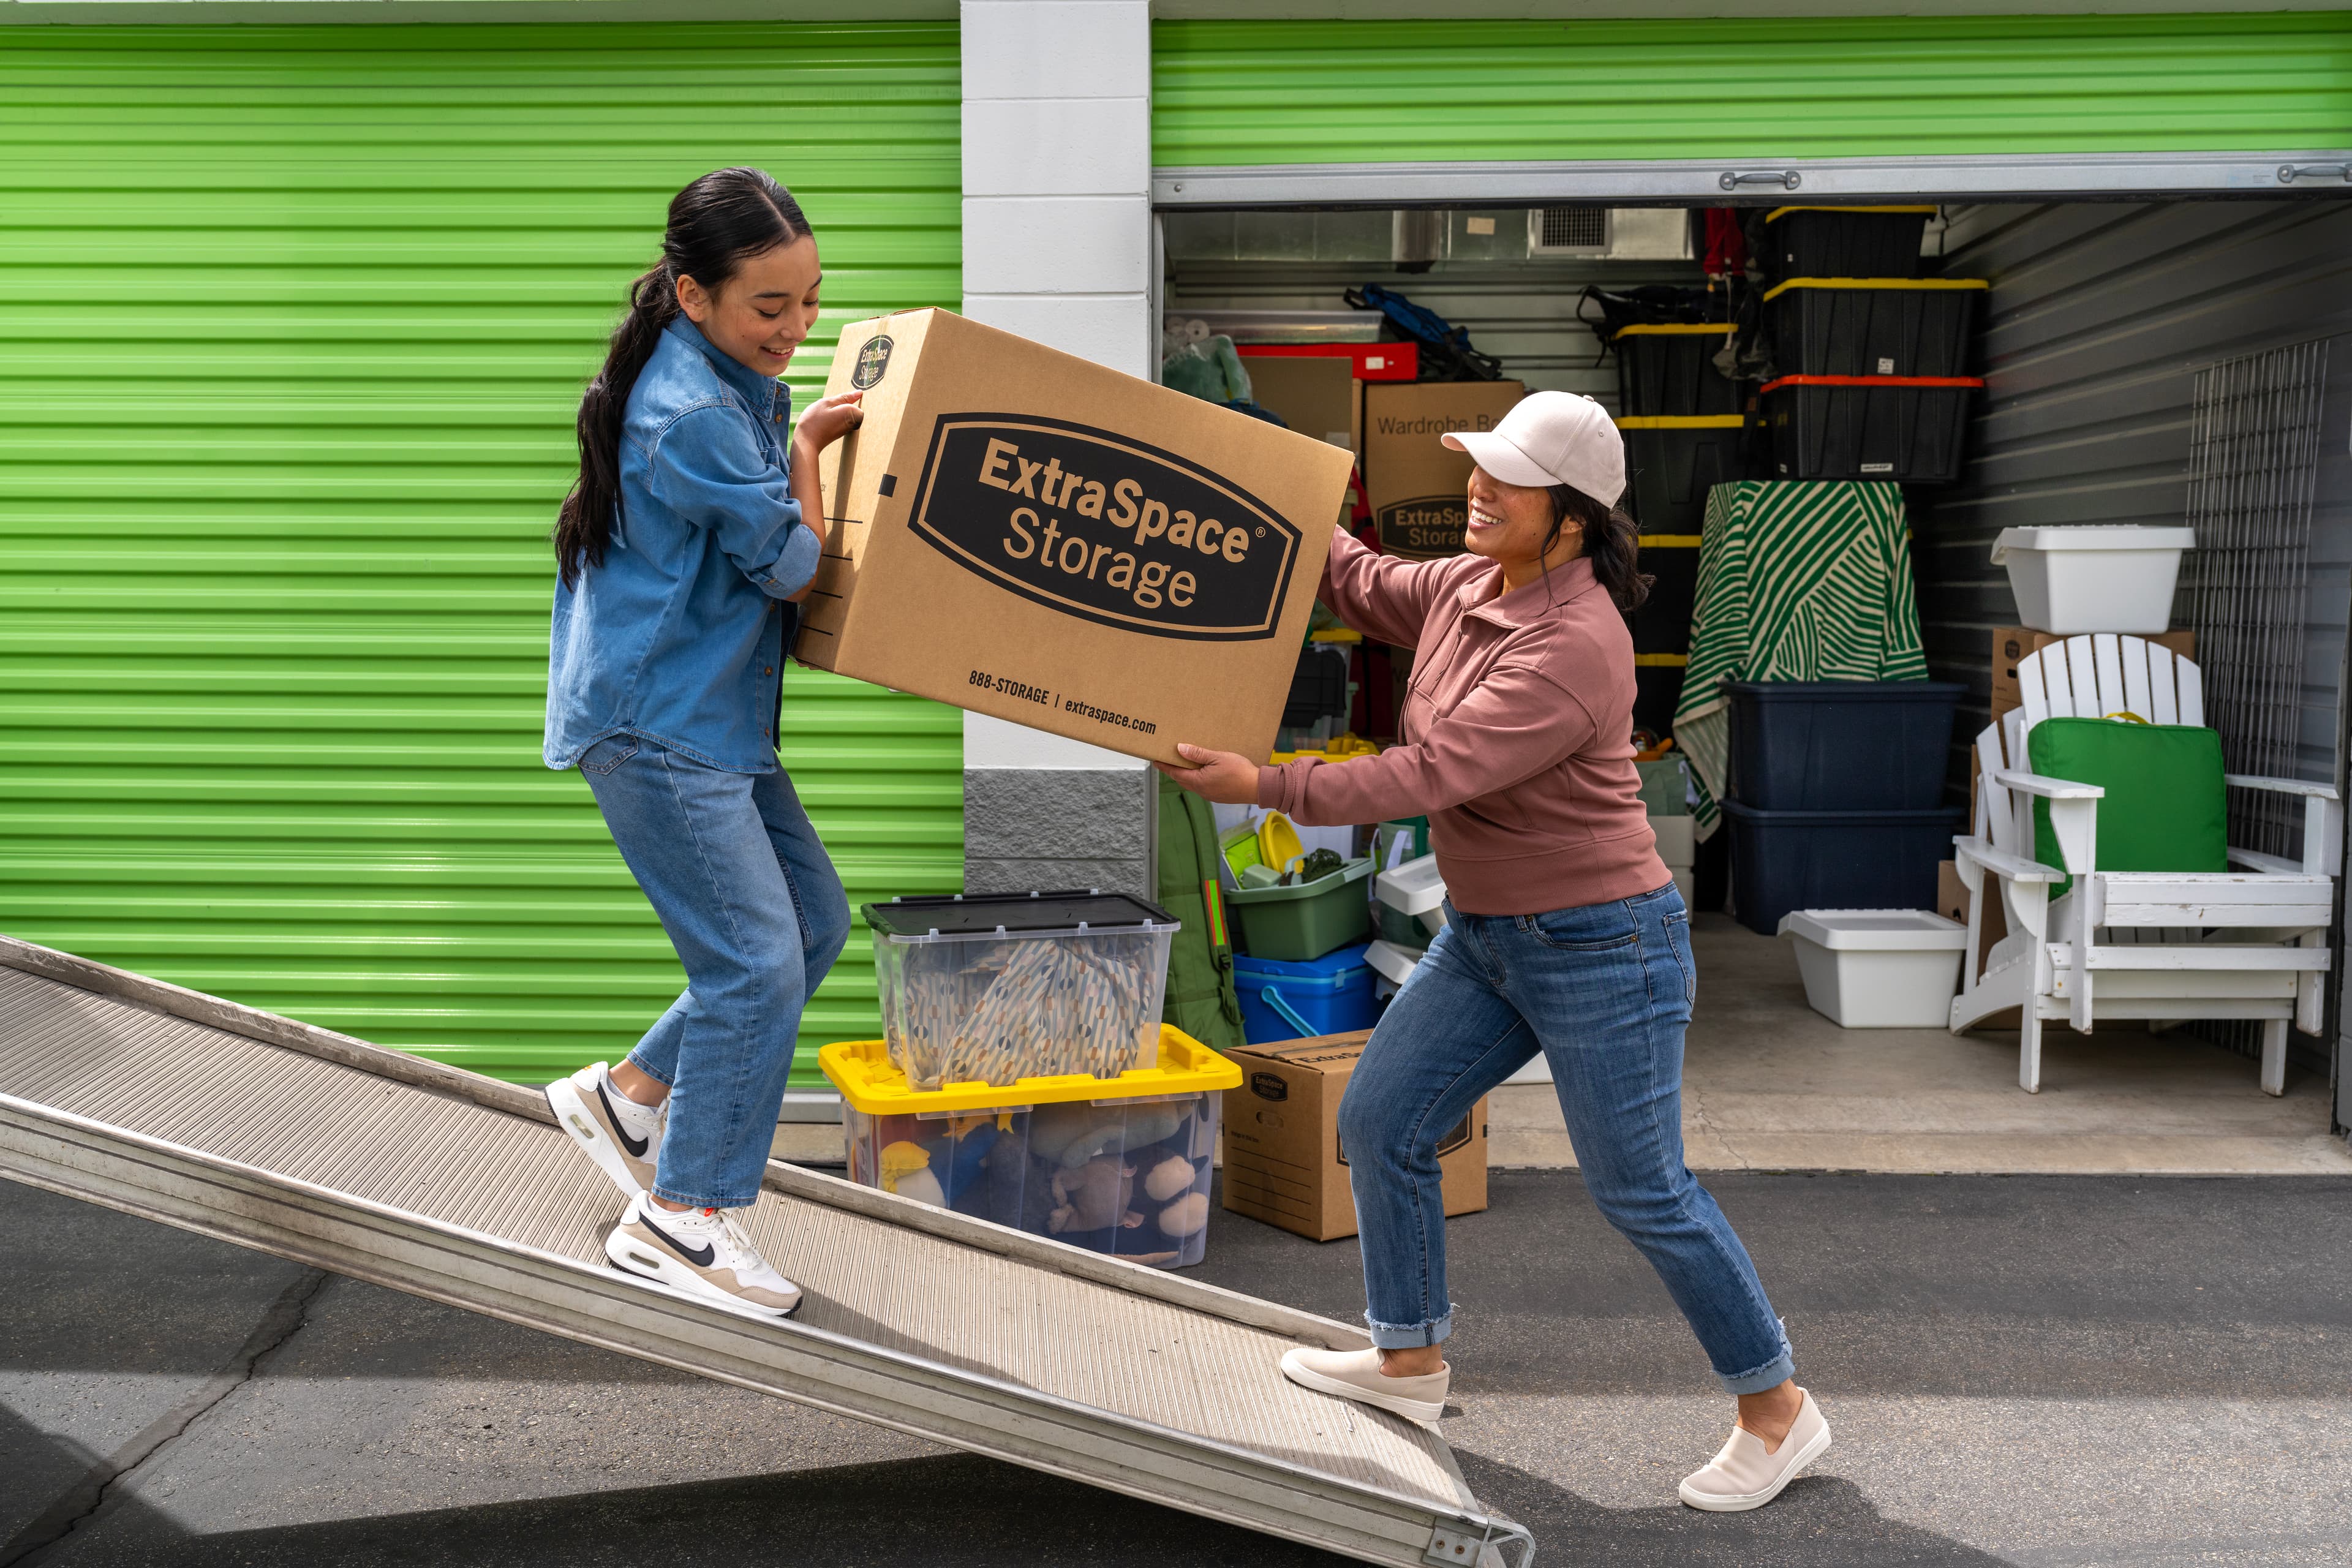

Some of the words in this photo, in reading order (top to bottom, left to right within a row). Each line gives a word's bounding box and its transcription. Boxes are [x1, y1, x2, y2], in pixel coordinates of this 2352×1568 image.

[1378, 415, 1469, 434] Wardrobe
[1395, 507, 1469, 528] ExtraSp
[1003, 507, 1196, 609] Storage
[969, 670, 1050, 705] 888-STORAGE
[1065, 699, 1157, 735] extraspace.com
